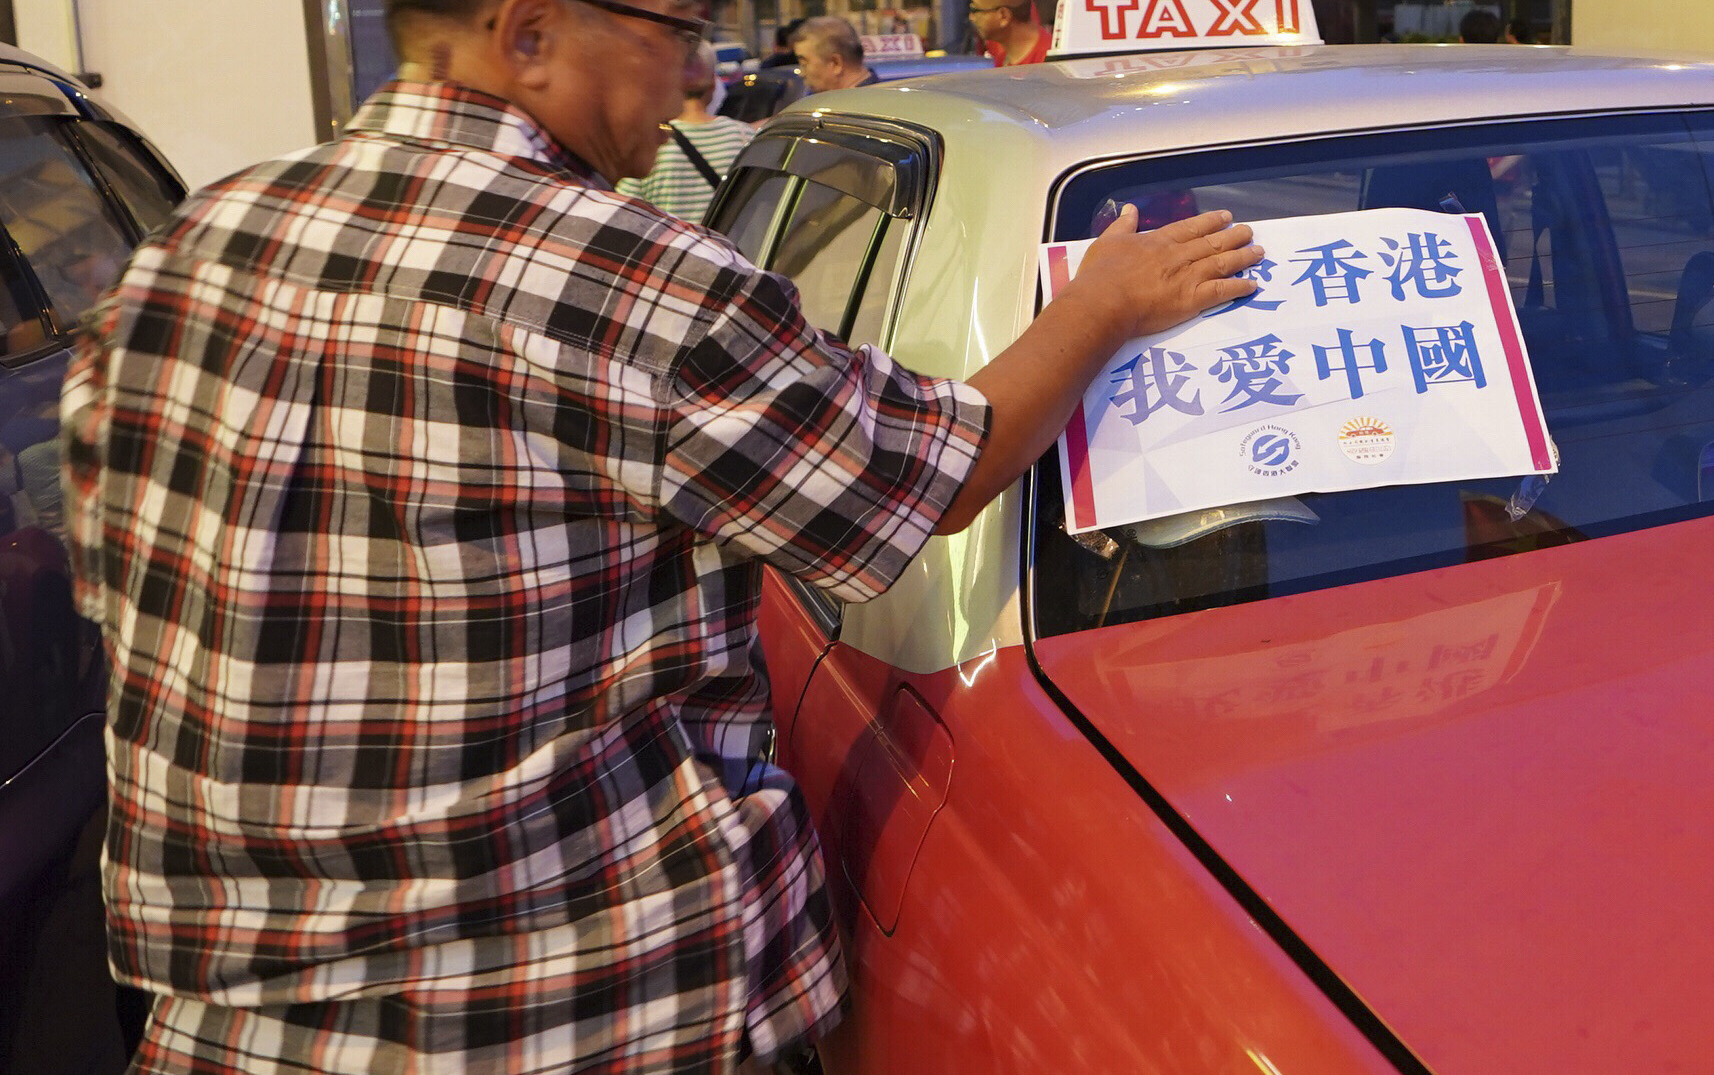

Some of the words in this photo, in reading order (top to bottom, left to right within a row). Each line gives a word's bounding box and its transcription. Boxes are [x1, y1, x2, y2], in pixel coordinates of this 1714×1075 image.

[861, 35, 914, 53] AXI
[1109, 320, 1488, 427] 我愛中國
[1267, 424, 1289, 435] Hong
[1289, 431, 1301, 450] Kong
